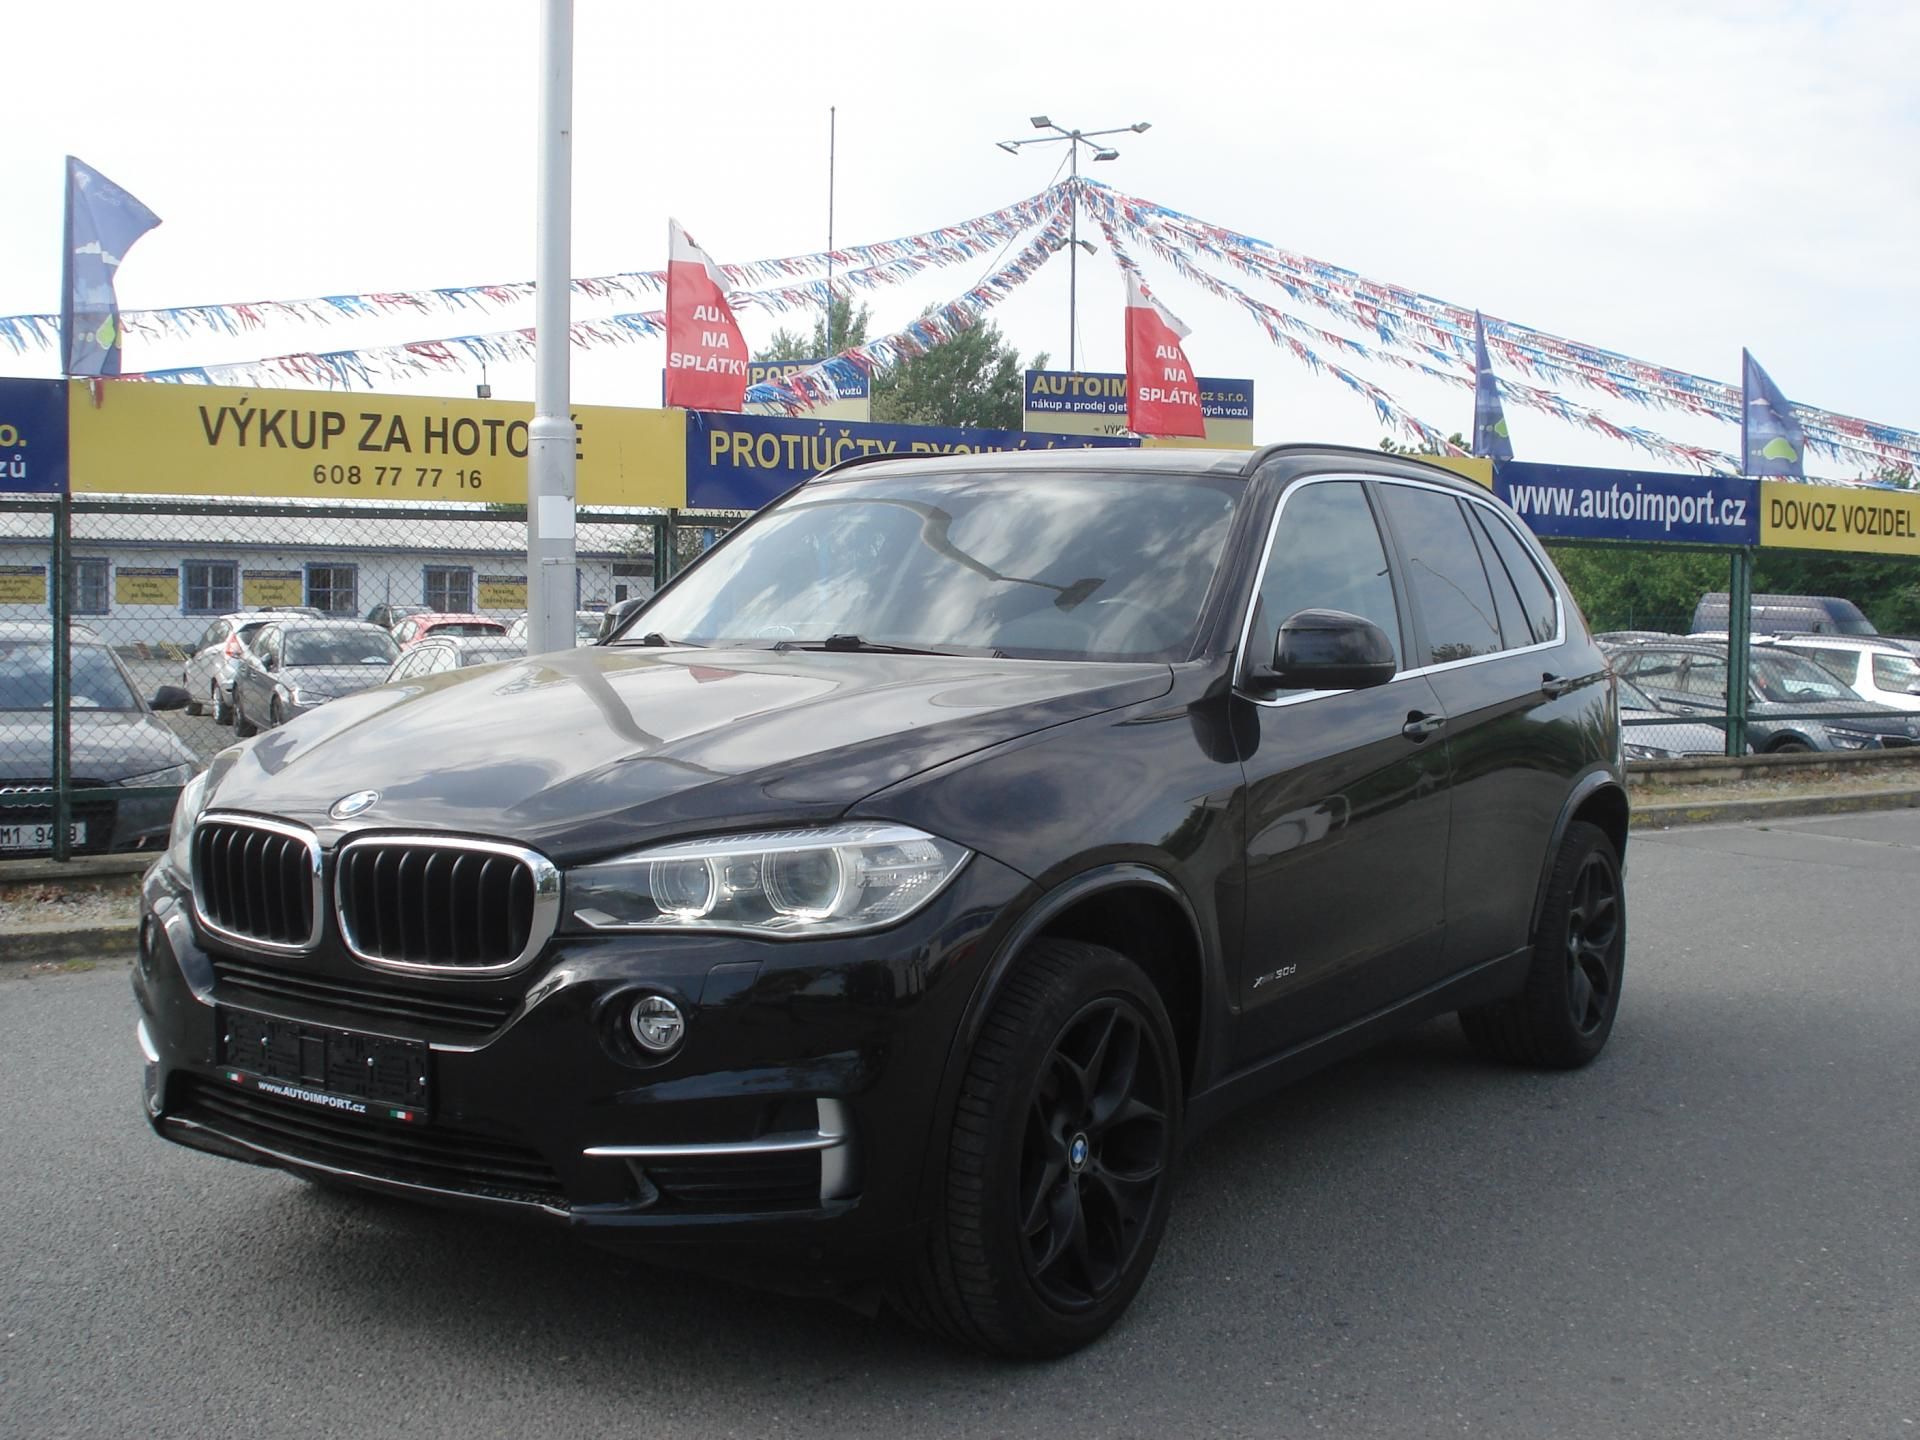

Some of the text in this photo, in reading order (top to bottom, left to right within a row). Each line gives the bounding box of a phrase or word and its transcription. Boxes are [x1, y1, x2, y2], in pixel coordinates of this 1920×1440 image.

[701, 331, 729, 349] NA
[669, 352, 747, 376] SPLÁTKY
[1164, 367, 1187, 383] NA
[1032, 375, 1127, 397] AUTOIM
[1217, 391, 1248, 402] s.r.o.
[1140, 386, 1198, 406] SPLÁTK
[1031, 399, 1062, 411] nákup
[1074, 401, 1106, 413] prodej
[1108, 403, 1127, 413] ojet
[1200, 405, 1224, 418] ných
[1225, 405, 1248, 416] vozů
[199, 398, 584, 460] VÝKUP ZA HOTO
[313, 464, 482, 489] 608 77 77 16
[1509, 482, 1747, 532] www.autoimport.cz
[1770, 499, 1917, 538] DOVOZ VOZIDEL
[258, 1080, 366, 1114] www.AUTOIMPORT.cz
